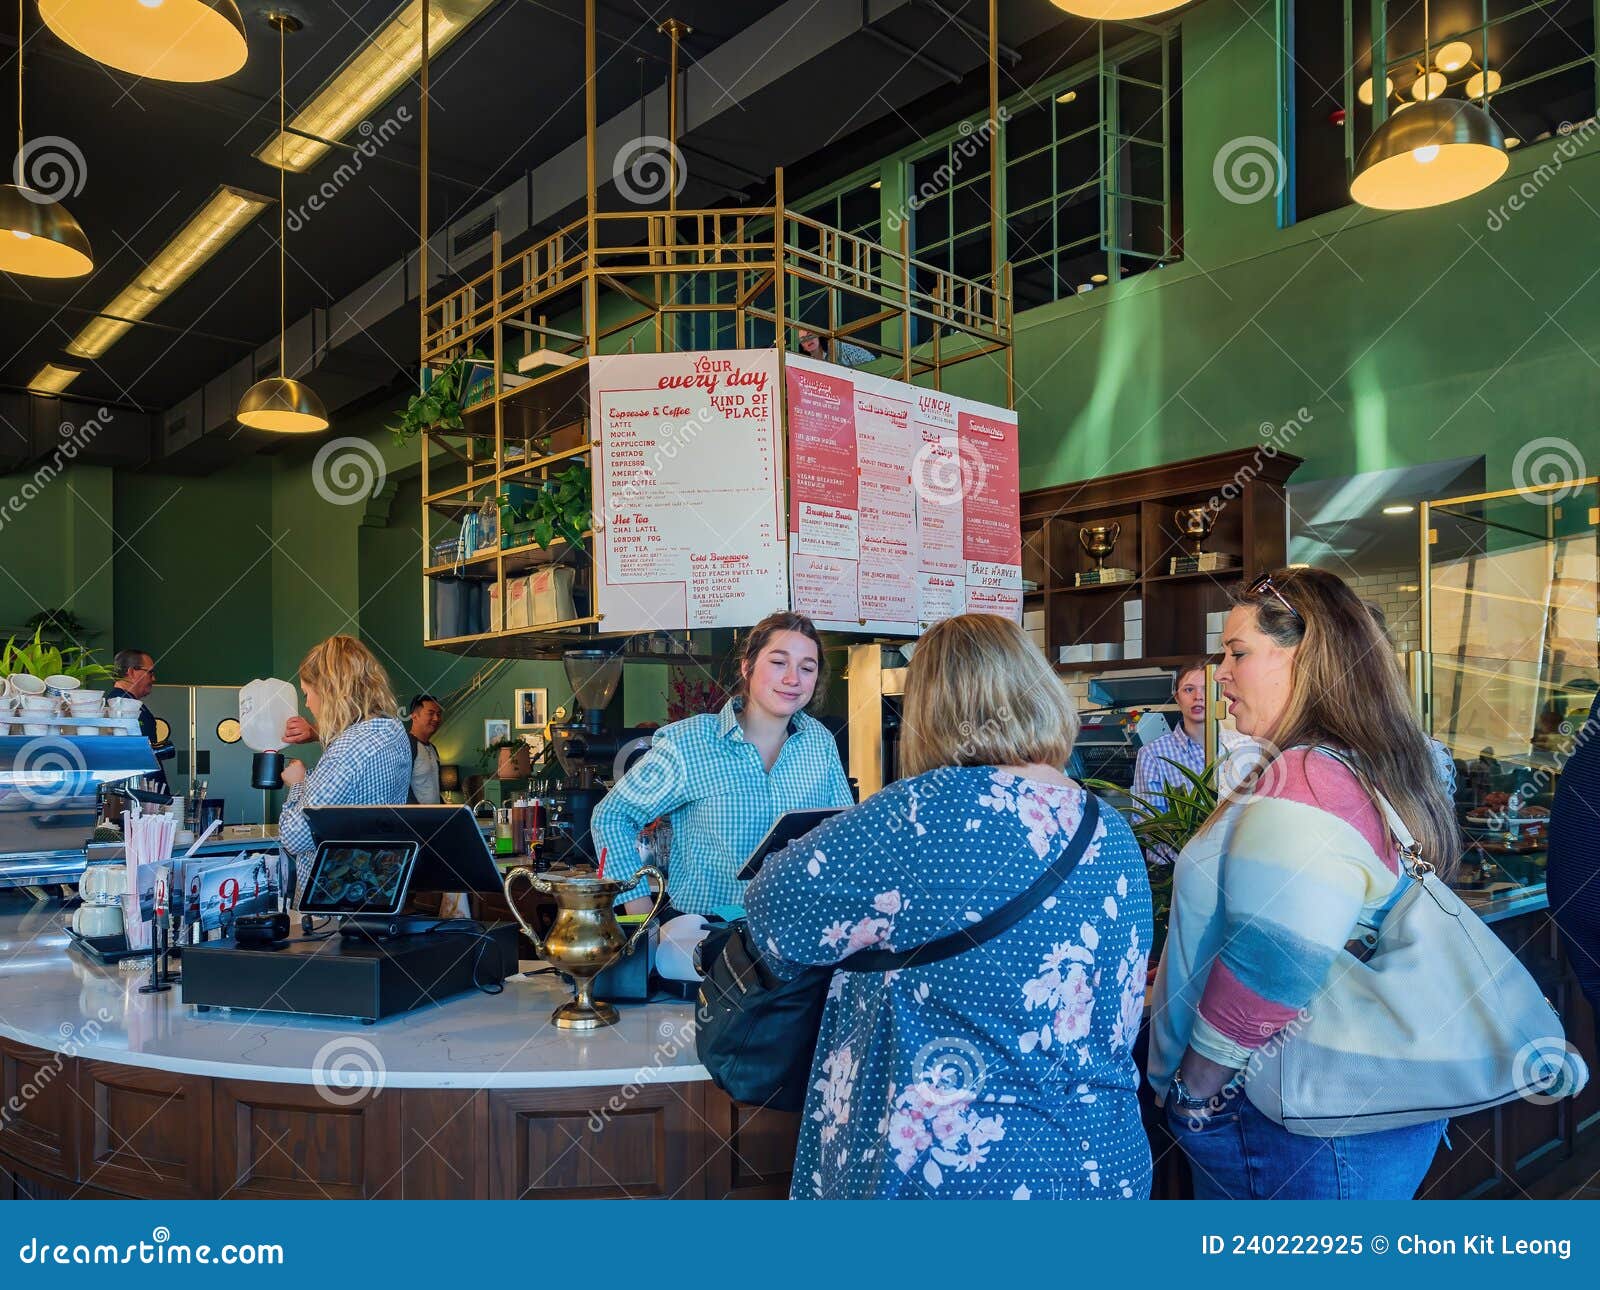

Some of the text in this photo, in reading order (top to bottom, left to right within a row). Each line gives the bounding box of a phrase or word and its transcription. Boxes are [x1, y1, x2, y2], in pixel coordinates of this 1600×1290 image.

[693, 355, 732, 373] YOUR
[657, 368, 769, 395] every day
[710, 393, 768, 412] KIND OF
[918, 395, 951, 413] LUNCH
[609, 405, 690, 419] Espresso & Coffee
[725, 407, 768, 419] PLACE
[610, 431, 637, 439] MOCHA
[969, 420, 1005, 441] Sandwiches
[610, 440, 656, 448] CAPPUCCINO
[610, 450, 644, 458] CORTADO
[612, 469, 654, 477] AMERICANO
[631, 479, 657, 487] COFFEE
[612, 512, 649, 525] Hot Tea
[636, 525, 657, 533] LATTE
[690, 553, 707, 562] Cold
[709, 552, 749, 563] Beverages
[971, 562, 989, 575] TAKE
[982, 576, 1002, 587] HOME
[219, 878, 239, 914] 9
